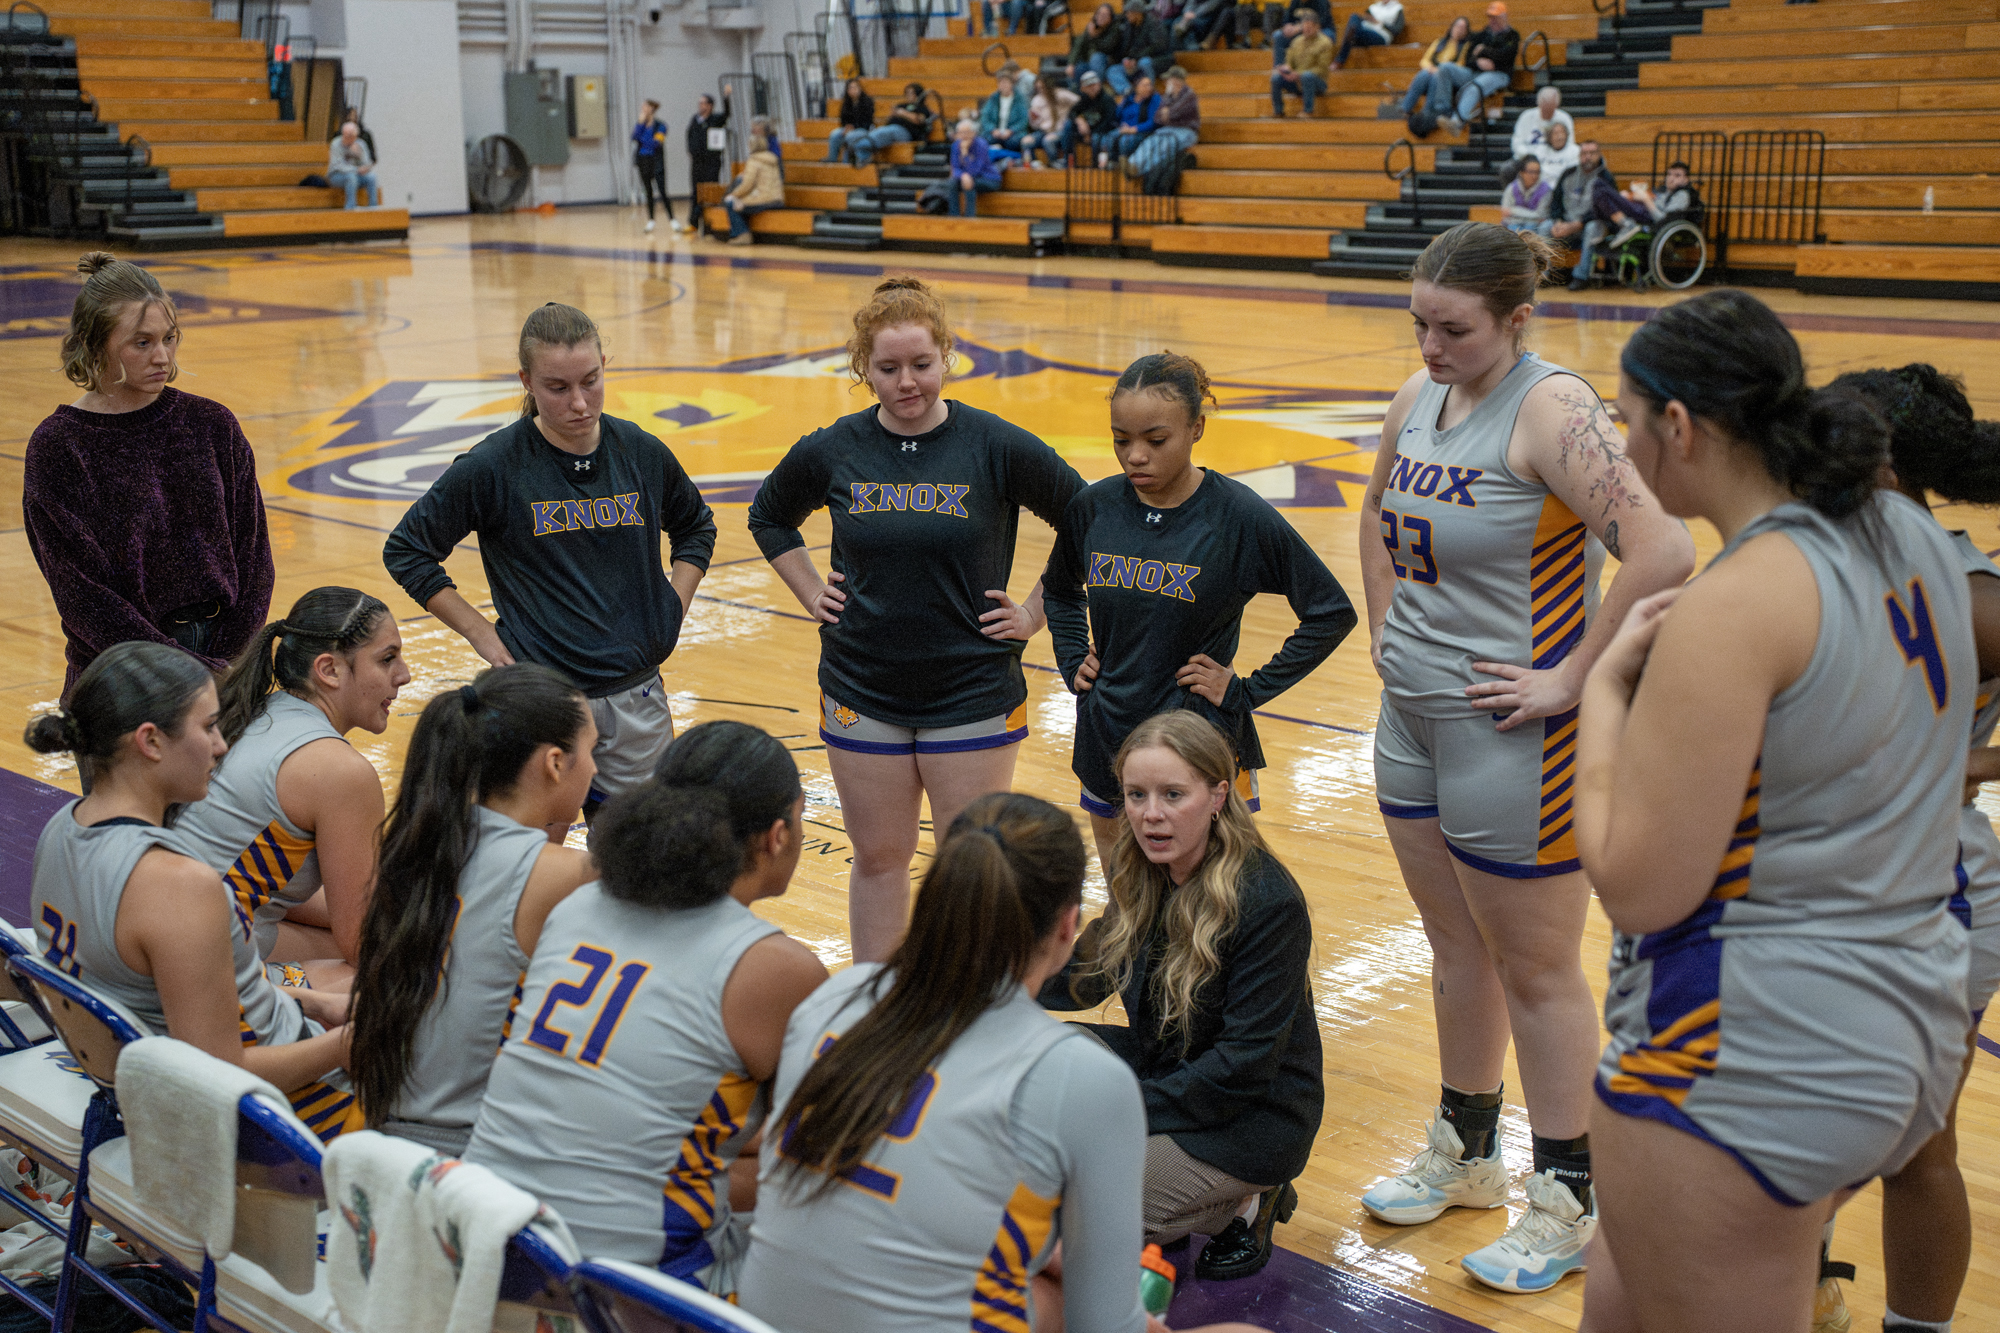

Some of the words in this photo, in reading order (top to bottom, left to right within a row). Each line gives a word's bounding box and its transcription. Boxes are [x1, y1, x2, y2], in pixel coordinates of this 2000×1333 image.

[849, 482, 970, 519] KNOX
[1385, 452, 1484, 508] NOX
[530, 492, 645, 537] KNOX
[1381, 507, 1440, 586] 23
[1088, 552, 1201, 603] KNOX
[1883, 574, 1952, 718] 4
[522, 942, 653, 1070] 21
